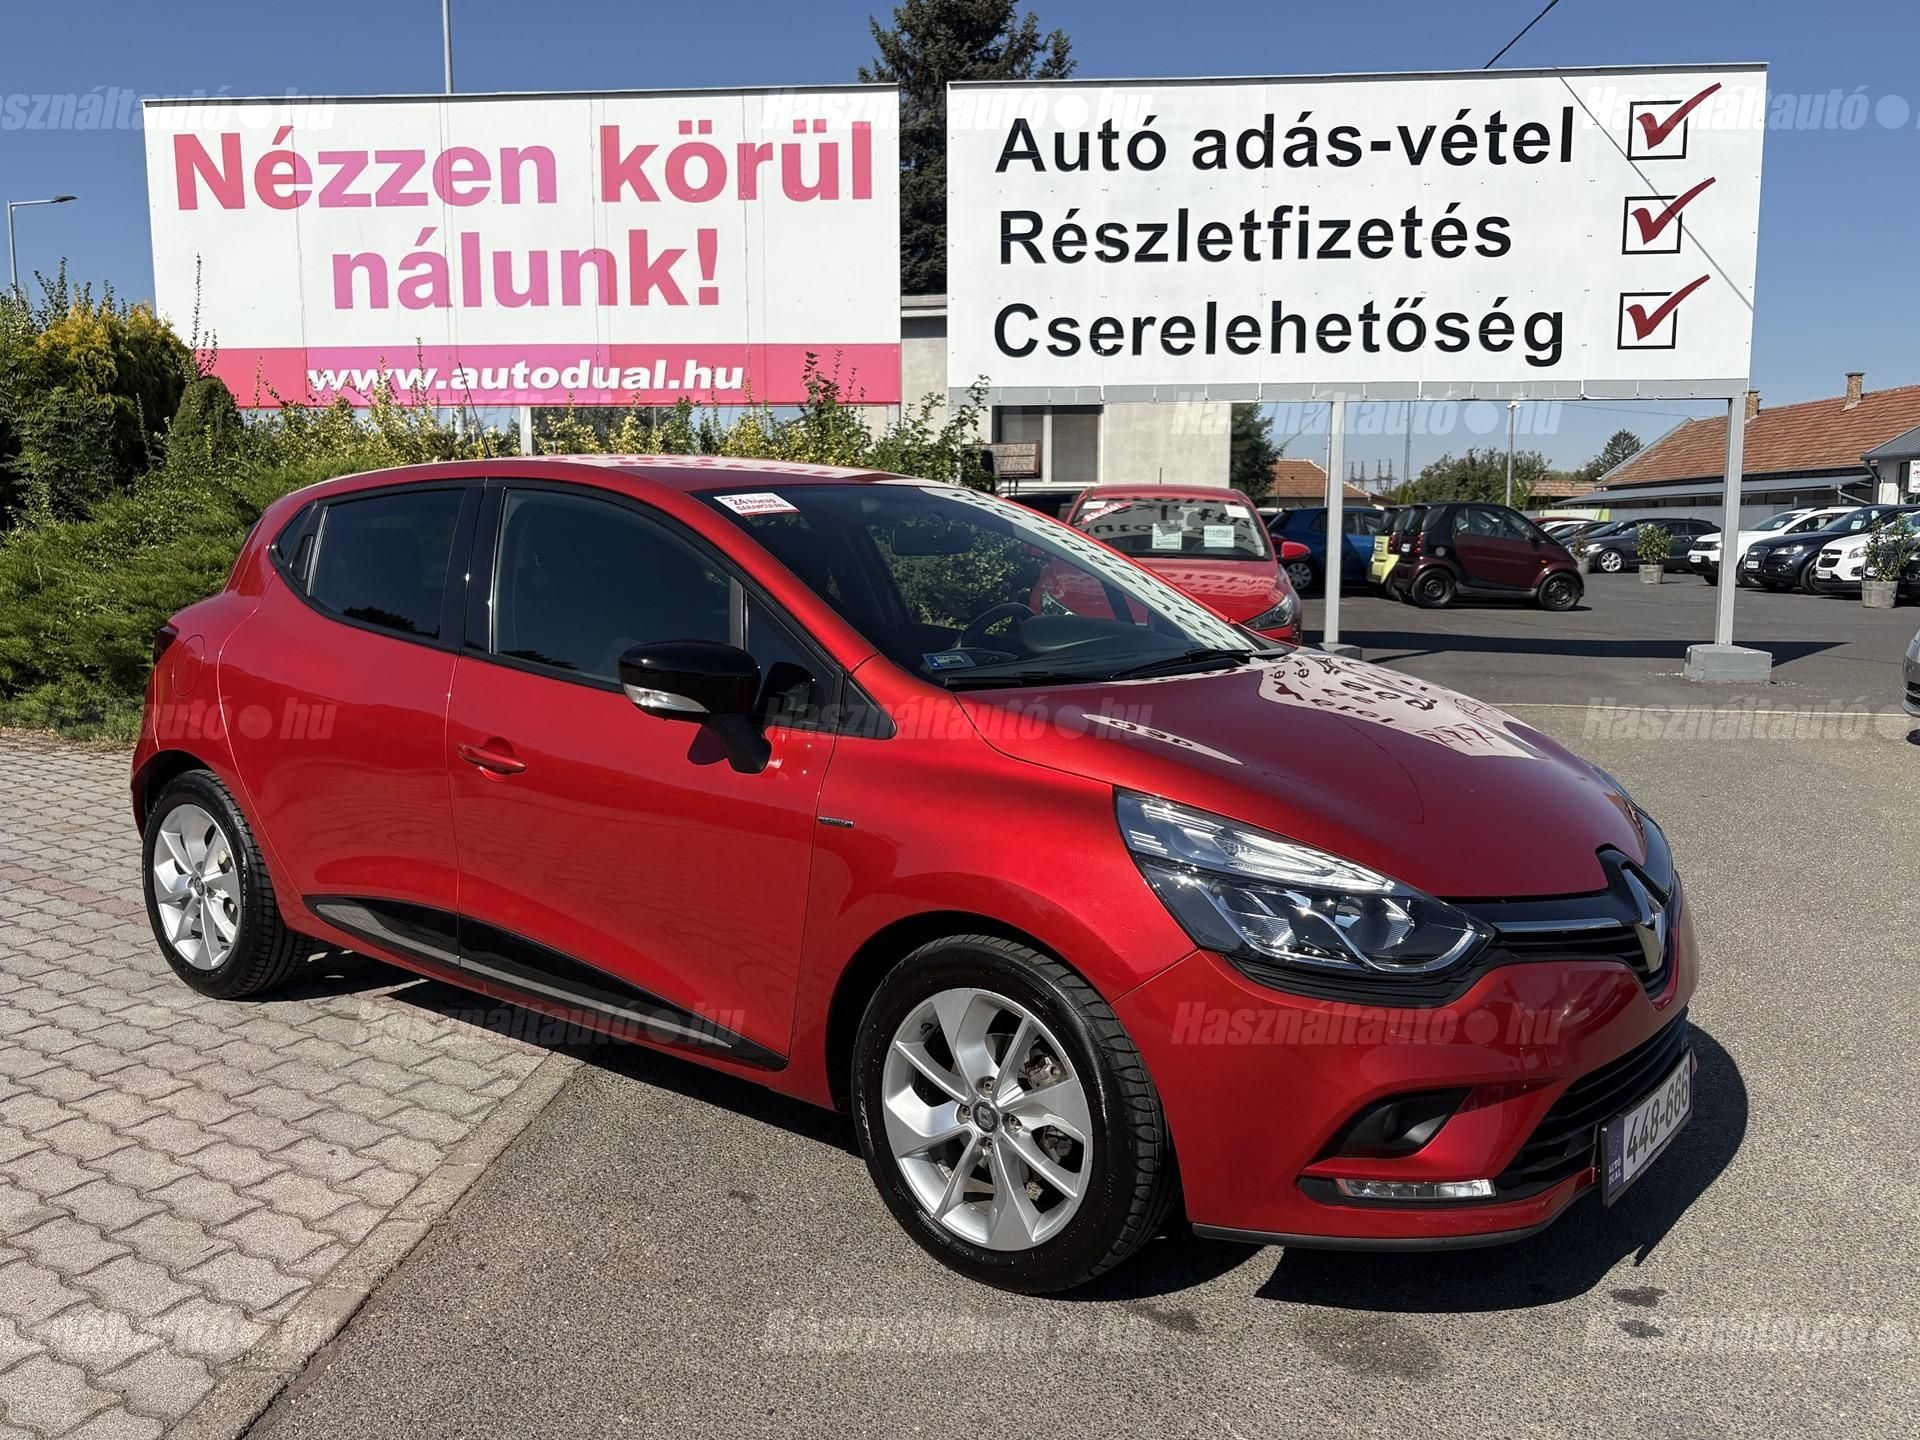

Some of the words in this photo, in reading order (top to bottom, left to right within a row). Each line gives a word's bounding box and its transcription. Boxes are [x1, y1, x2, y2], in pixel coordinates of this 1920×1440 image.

[173, 126, 557, 210] Nézzen
[600, 119, 872, 202] körül
[995, 114, 1167, 173] Autó
[1192, 106, 1574, 170] adás-vétel
[332, 227, 719, 310] nálunk!
[1000, 202, 1512, 265] Részletfizetés
[994, 297, 1563, 367] Cserelehetőség
[307, 359, 744, 391] www.autodual.hu
[1626, 1065, 1688, 1164] 448-666
